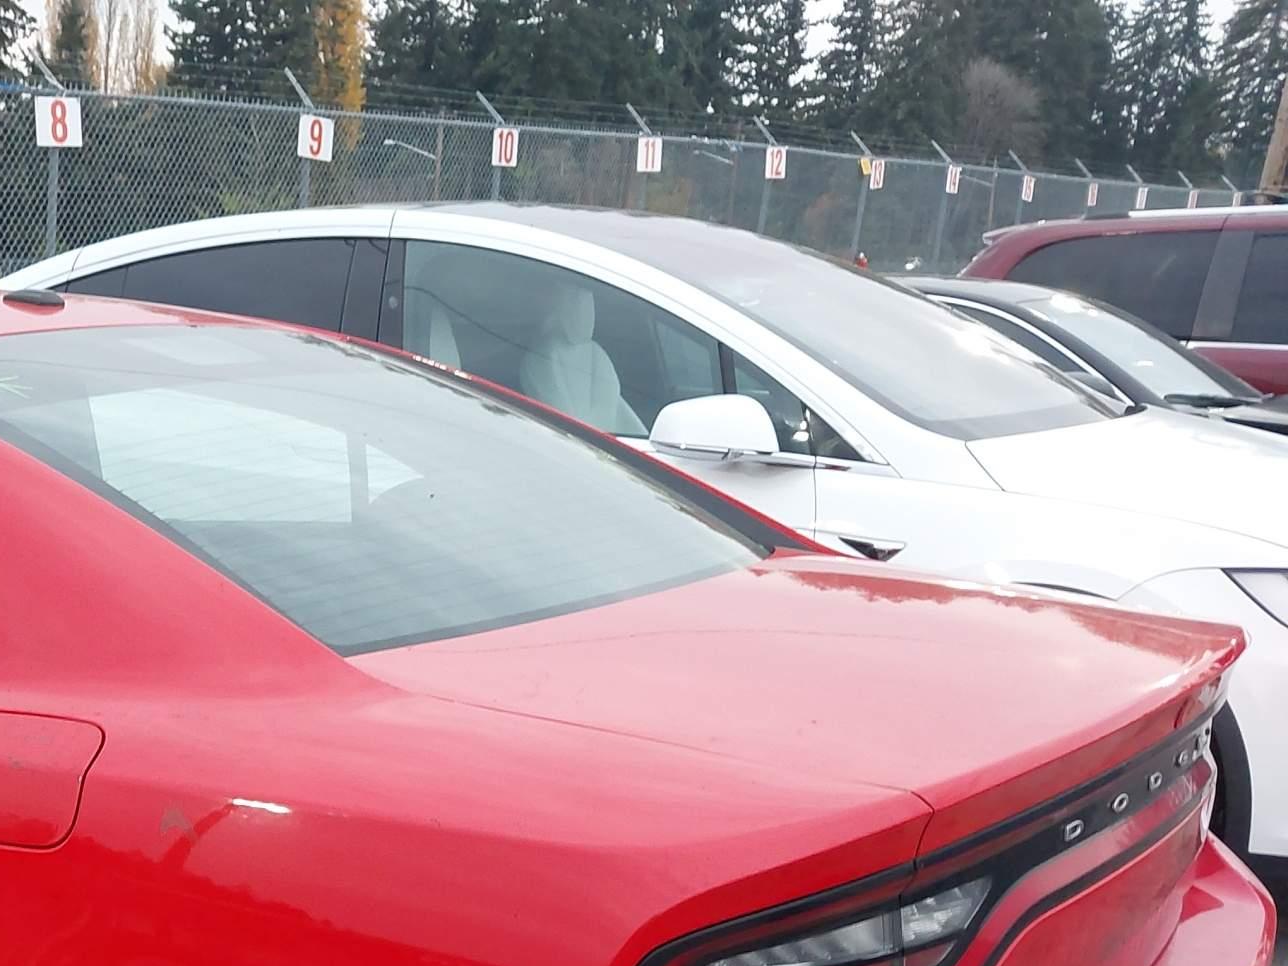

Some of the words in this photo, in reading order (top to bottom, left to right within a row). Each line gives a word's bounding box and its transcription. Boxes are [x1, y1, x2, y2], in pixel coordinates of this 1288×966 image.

[50, 98, 69, 145] 8
[309, 118, 324, 158] 9
[497, 130, 515, 166] 10
[642, 140, 657, 170] 11
[769, 149, 783, 178] 12
[872, 161, 883, 188] 13
